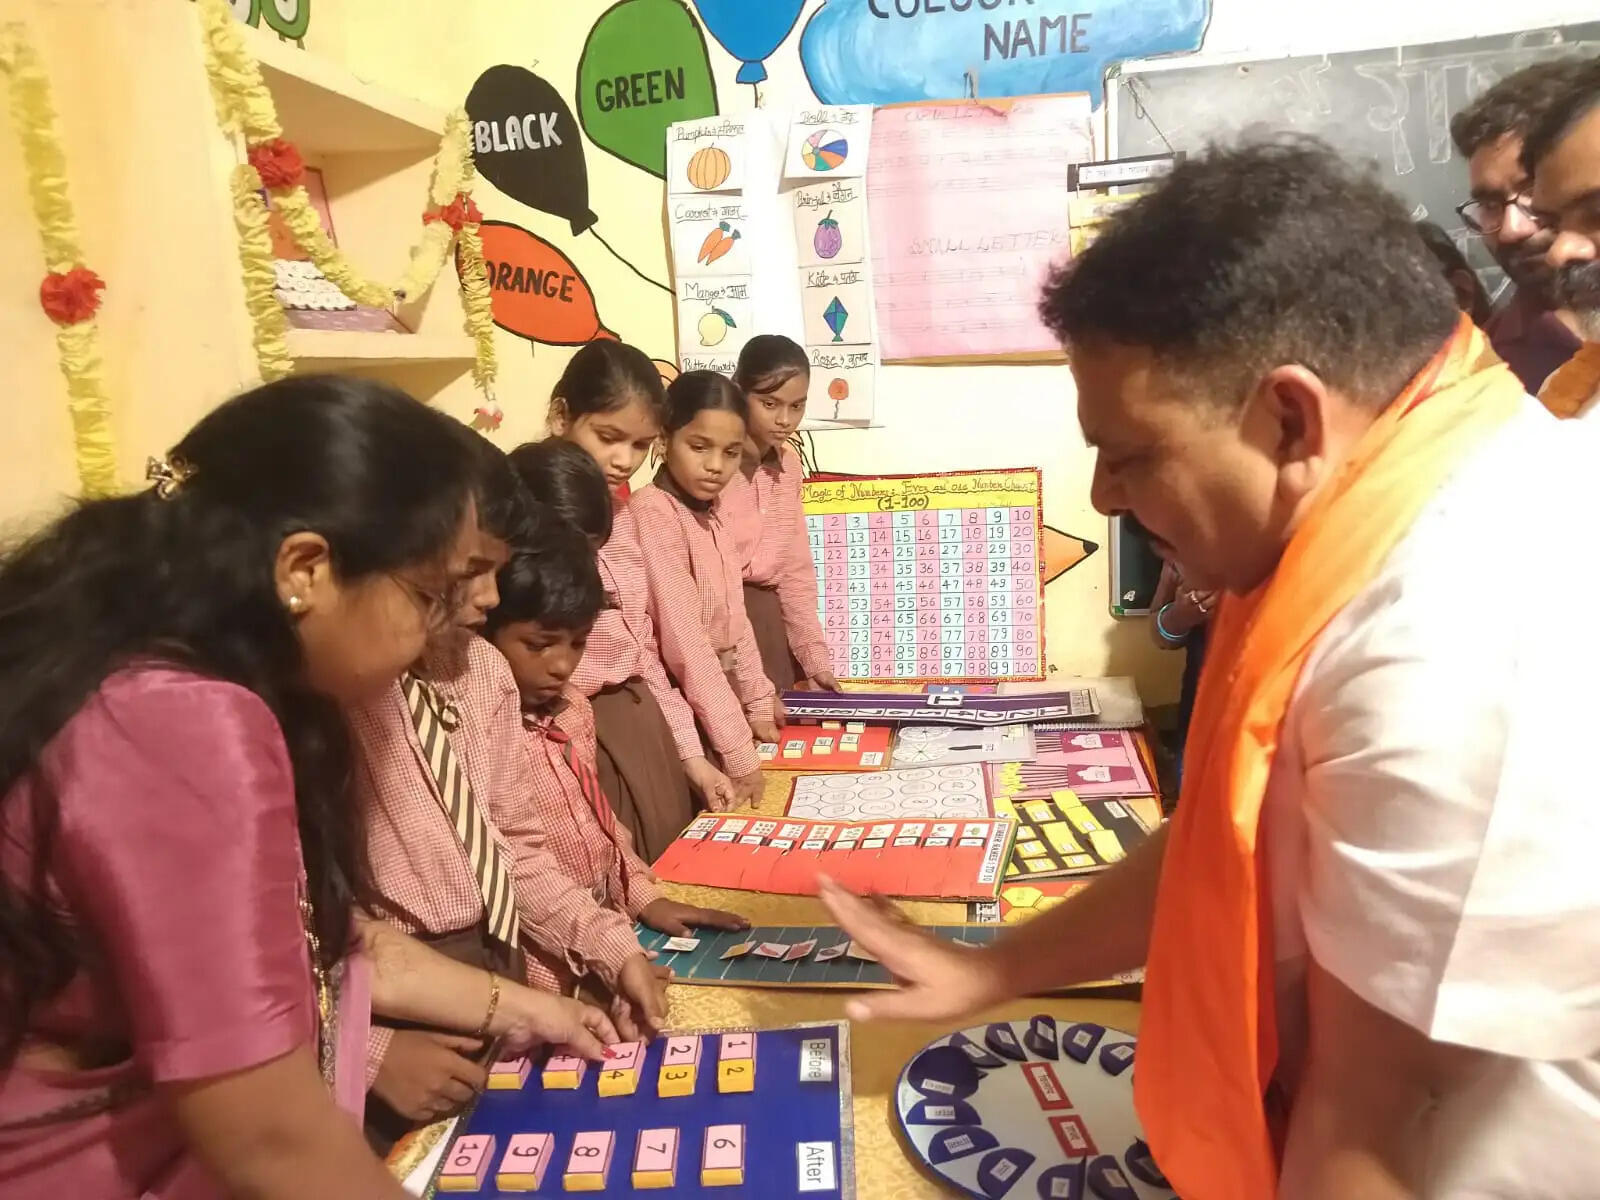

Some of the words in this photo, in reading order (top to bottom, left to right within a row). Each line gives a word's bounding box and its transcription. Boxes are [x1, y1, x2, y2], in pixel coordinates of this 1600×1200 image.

[984, 13, 1093, 61] NAME
[595, 67, 685, 112] GREEN
[474, 112, 562, 153] BLACK
[685, 282, 720, 305] Mango
[801, 485, 832, 501] Magic
[836, 484, 846, 498] of
[877, 494, 929, 512] (1-100)
[808, 518, 817, 528] 1
[831, 516, 840, 527] 2
[852, 516, 861, 528] 3
[875, 516, 885, 524] 4
[900, 514, 911, 525] 5
[921, 513, 930, 525] 6
[945, 513, 954, 526] 7
[969, 512, 978, 524] 8
[994, 510, 1002, 523] 9
[1014, 510, 1031, 521] 10
[826, 533, 842, 544] 12
[850, 532, 865, 543] 13
[872, 531, 888, 543] 14
[896, 530, 911, 542] 15
[918, 529, 932, 541] 16
[941, 528, 957, 539] 17
[966, 527, 981, 539] 18
[989, 526, 1004, 539] 19
[1013, 526, 1032, 537] 20
[827, 550, 842, 560] 22
[850, 548, 866, 559] 23
[872, 547, 890, 558] 24
[896, 547, 914, 557] 25
[920, 545, 935, 555] 26
[941, 545, 958, 554] 27
[966, 544, 983, 554] 28
[989, 543, 1006, 553] 29
[1014, 543, 1031, 555] 30
[826, 566, 843, 578] 32
[850, 565, 866, 576] 33
[872, 565, 888, 575] 34
[896, 563, 912, 575] 35
[919, 562, 934, 574] 36
[941, 562, 960, 573] 37
[965, 562, 983, 573] 38
[990, 561, 1006, 573] 39
[1012, 561, 1031, 571] 40
[826, 582, 842, 593] 42
[849, 582, 866, 593] 43
[873, 581, 888, 591] 44
[896, 580, 913, 591] 45
[919, 580, 934, 589] 46
[941, 579, 959, 590] 47
[966, 579, 982, 588] 48
[990, 579, 1006, 588] 49
[1016, 579, 1033, 590] 50
[828, 599, 844, 610] 52
[851, 598, 868, 610] 53
[874, 599, 891, 610] 54
[897, 597, 916, 609] 55
[920, 597, 936, 607] 56
[944, 597, 961, 607] 57
[968, 596, 984, 608] 58
[991, 594, 1006, 607] 59
[1016, 595, 1033, 606] 60
[828, 615, 845, 627] 62
[851, 614, 869, 626] 63
[873, 614, 890, 625] 64
[897, 613, 914, 625] 65
[919, 613, 937, 625] 66
[944, 613, 961, 624] 67
[967, 611, 985, 624] 68
[991, 610, 1006, 622] 69
[1017, 611, 1032, 622] 70
[828, 630, 846, 641] 72
[851, 630, 869, 643] 73
[874, 630, 891, 643] 74
[897, 630, 914, 642] 75
[921, 629, 937, 640] 76
[945, 630, 961, 641] 77
[968, 629, 986, 641] 78
[991, 628, 1007, 640] 79
[1017, 629, 1033, 640] 80
[851, 646, 869, 660] 83
[873, 645, 892, 660] 84
[896, 645, 915, 660] 85
[920, 645, 938, 659] 86
[944, 646, 962, 658] 87
[968, 646, 986, 659] 88
[991, 644, 1008, 658] 89
[1016, 644, 1032, 657] 90
[852, 663, 869, 676] 93
[874, 663, 892, 676] 94
[897, 662, 914, 676] 95
[920, 663, 938, 676] 96
[944, 662, 963, 677] 97
[967, 662, 986, 676] 98
[991, 661, 1009, 675] 99
[1015, 662, 1036, 673] 100
[934, 695, 960, 705] 1
[670, 1044, 692, 1057] 2
[727, 1040, 749, 1049] 1
[615, 1050, 634, 1061] 3
[808, 1042, 827, 1079] Before
[605, 1070, 625, 1081] 4
[665, 1071, 688, 1082] 3
[726, 1066, 745, 1077] 2
[511, 1145, 540, 1158] 9
[573, 1145, 601, 1158] 8
[646, 1142, 667, 1155] 7
[713, 1138, 737, 1150] 6
[453, 1141, 479, 1168] 10
[805, 1145, 825, 1184] After
